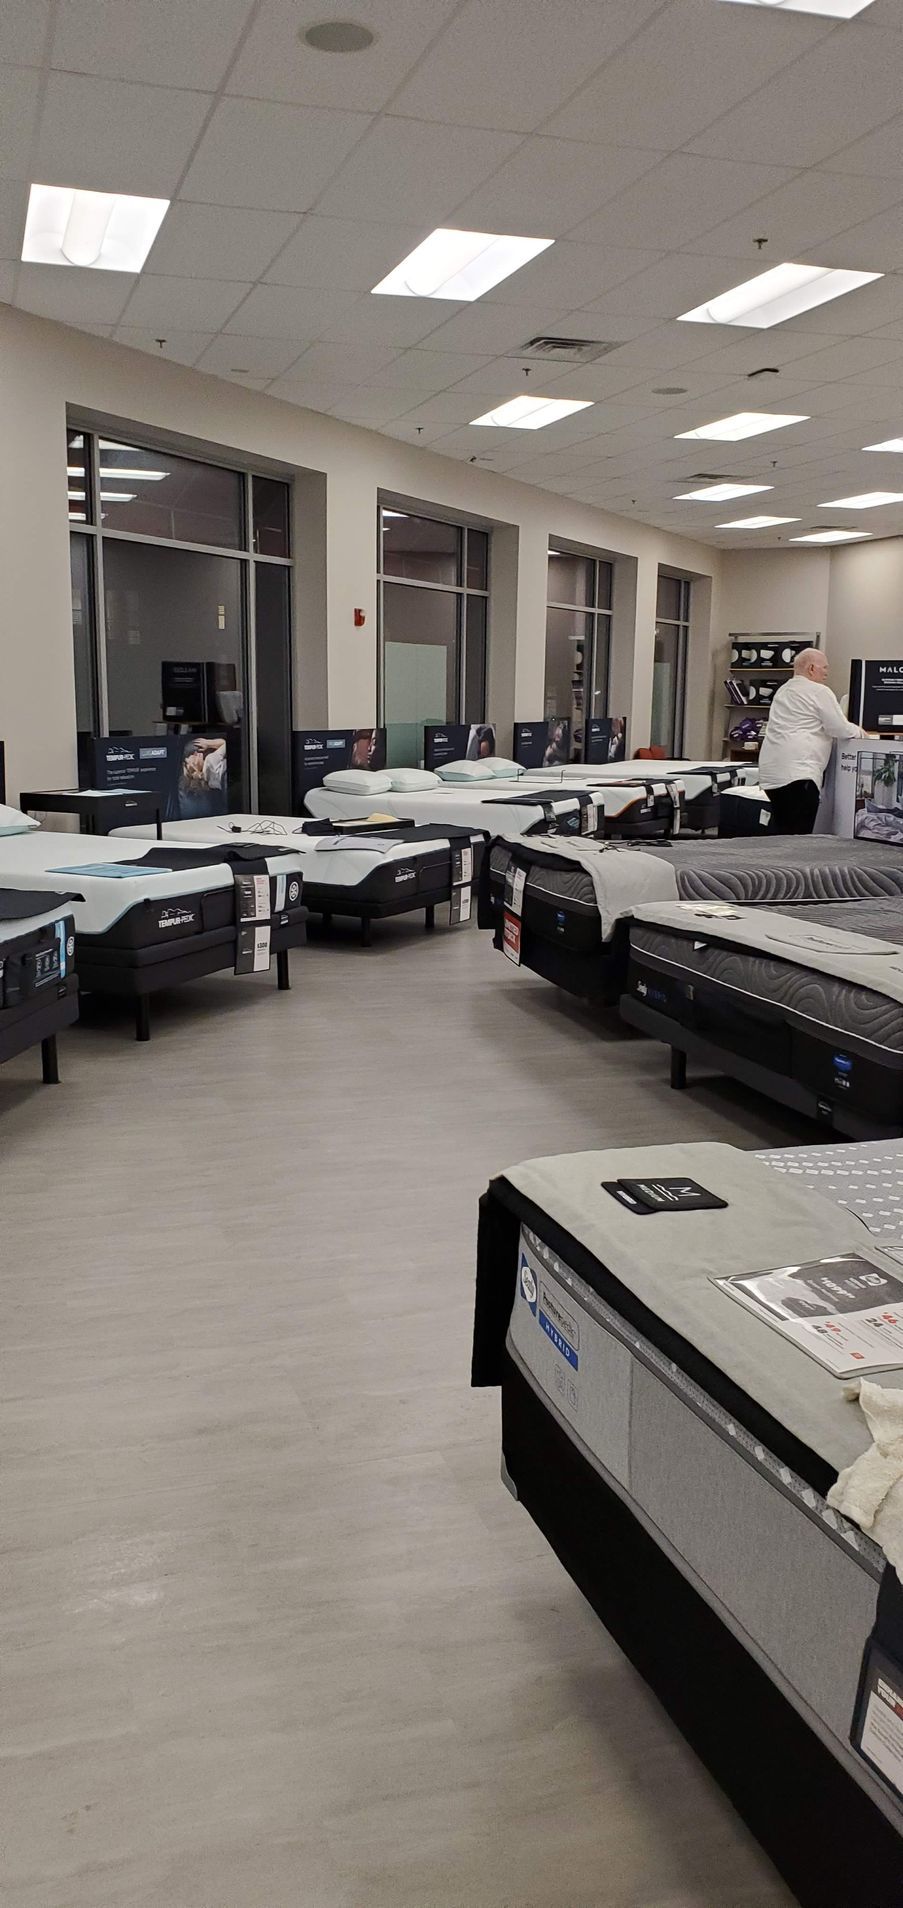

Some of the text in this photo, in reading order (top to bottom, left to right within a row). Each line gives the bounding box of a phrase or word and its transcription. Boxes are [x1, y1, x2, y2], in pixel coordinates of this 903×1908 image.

[158, 913, 196, 928] TEMPUR-PEDIC
[668, 1186, 701, 1197] M
[544, 1320, 571, 1357] HYBRID
